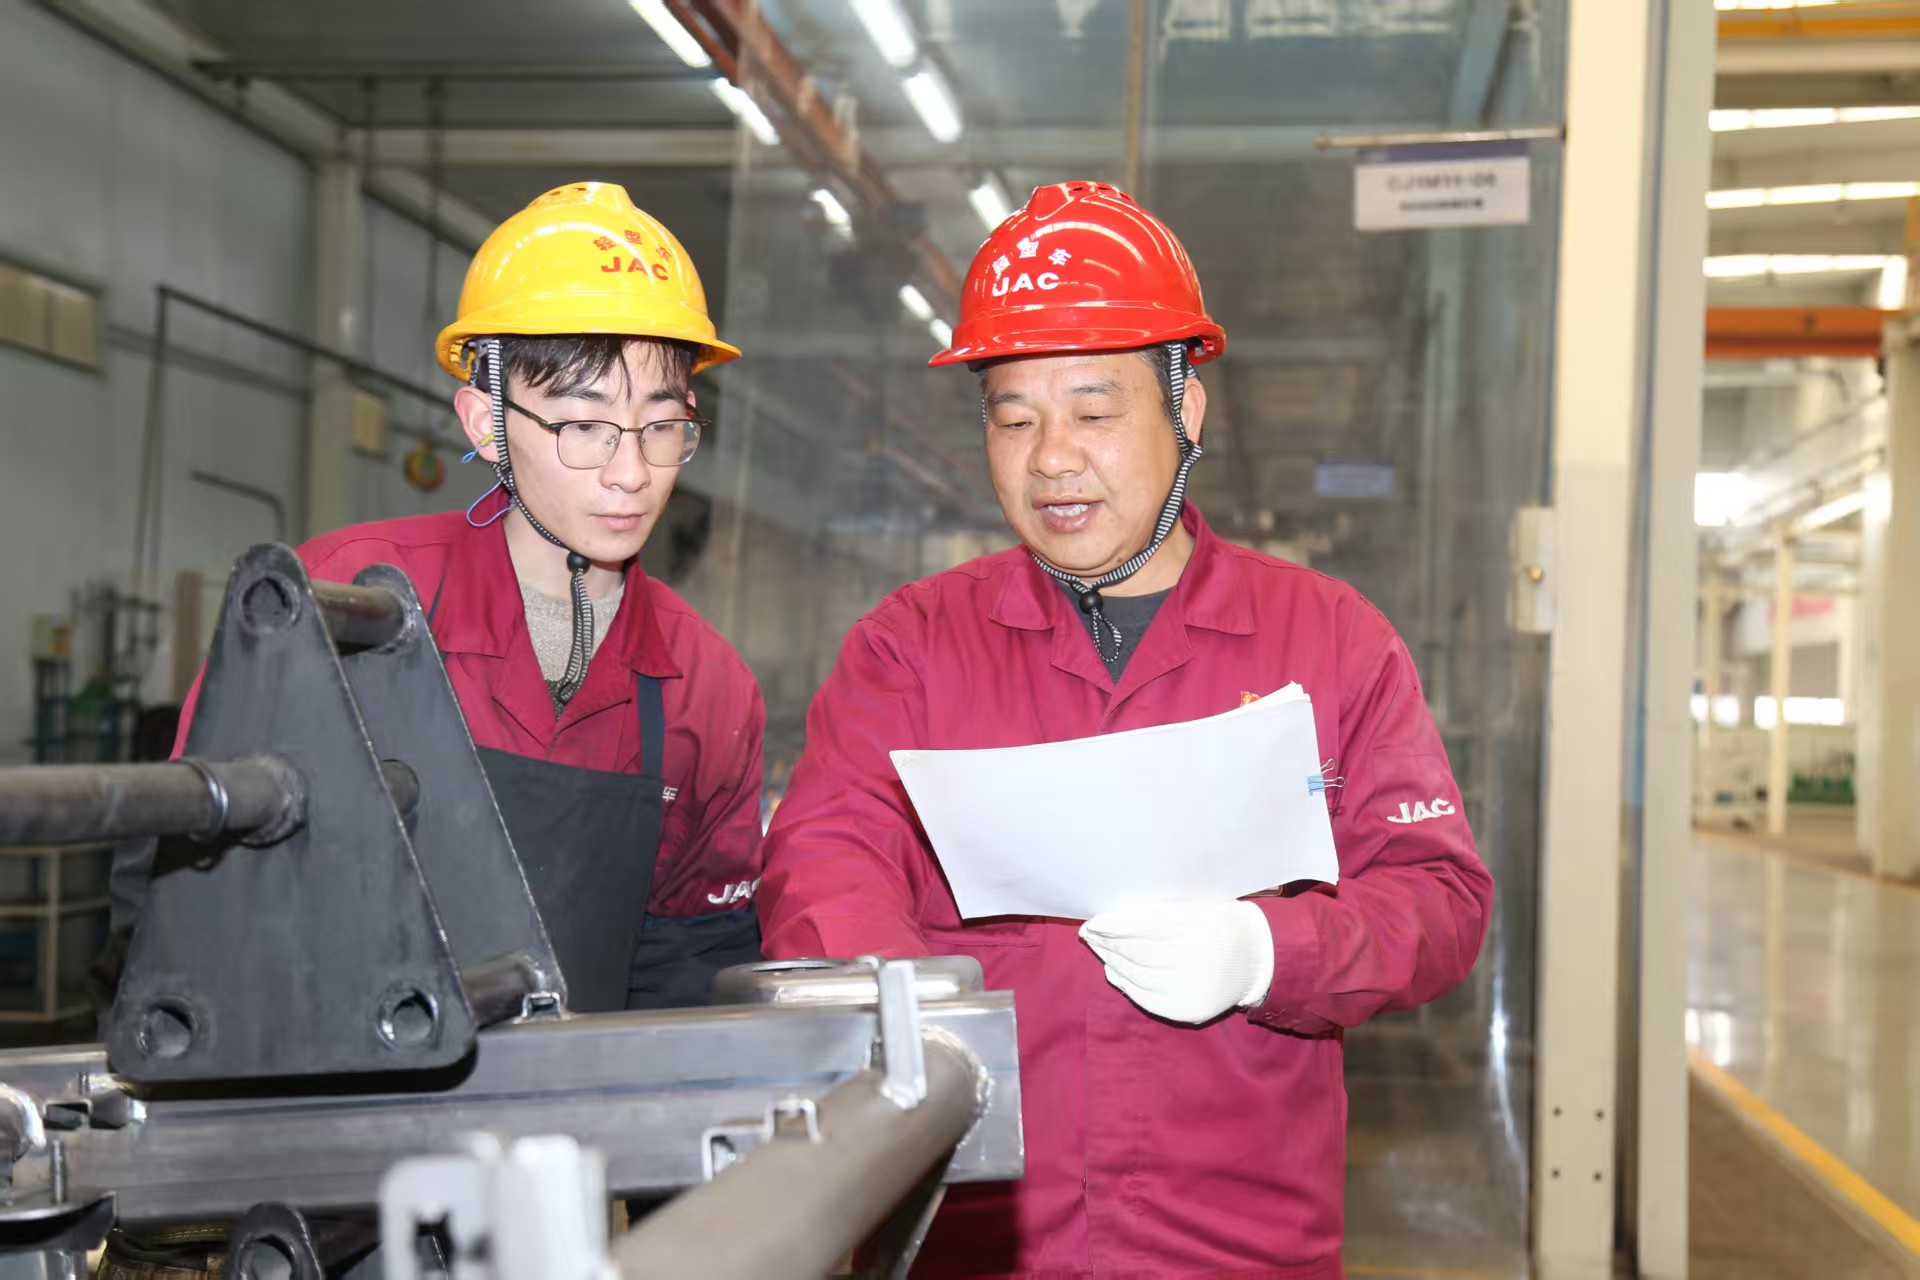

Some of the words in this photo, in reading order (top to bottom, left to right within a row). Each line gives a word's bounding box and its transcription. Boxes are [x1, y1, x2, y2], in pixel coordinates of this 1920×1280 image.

[600, 255, 669, 281] JAC
[991, 271, 1060, 297] JAC
[1386, 797, 1456, 824] JAC
